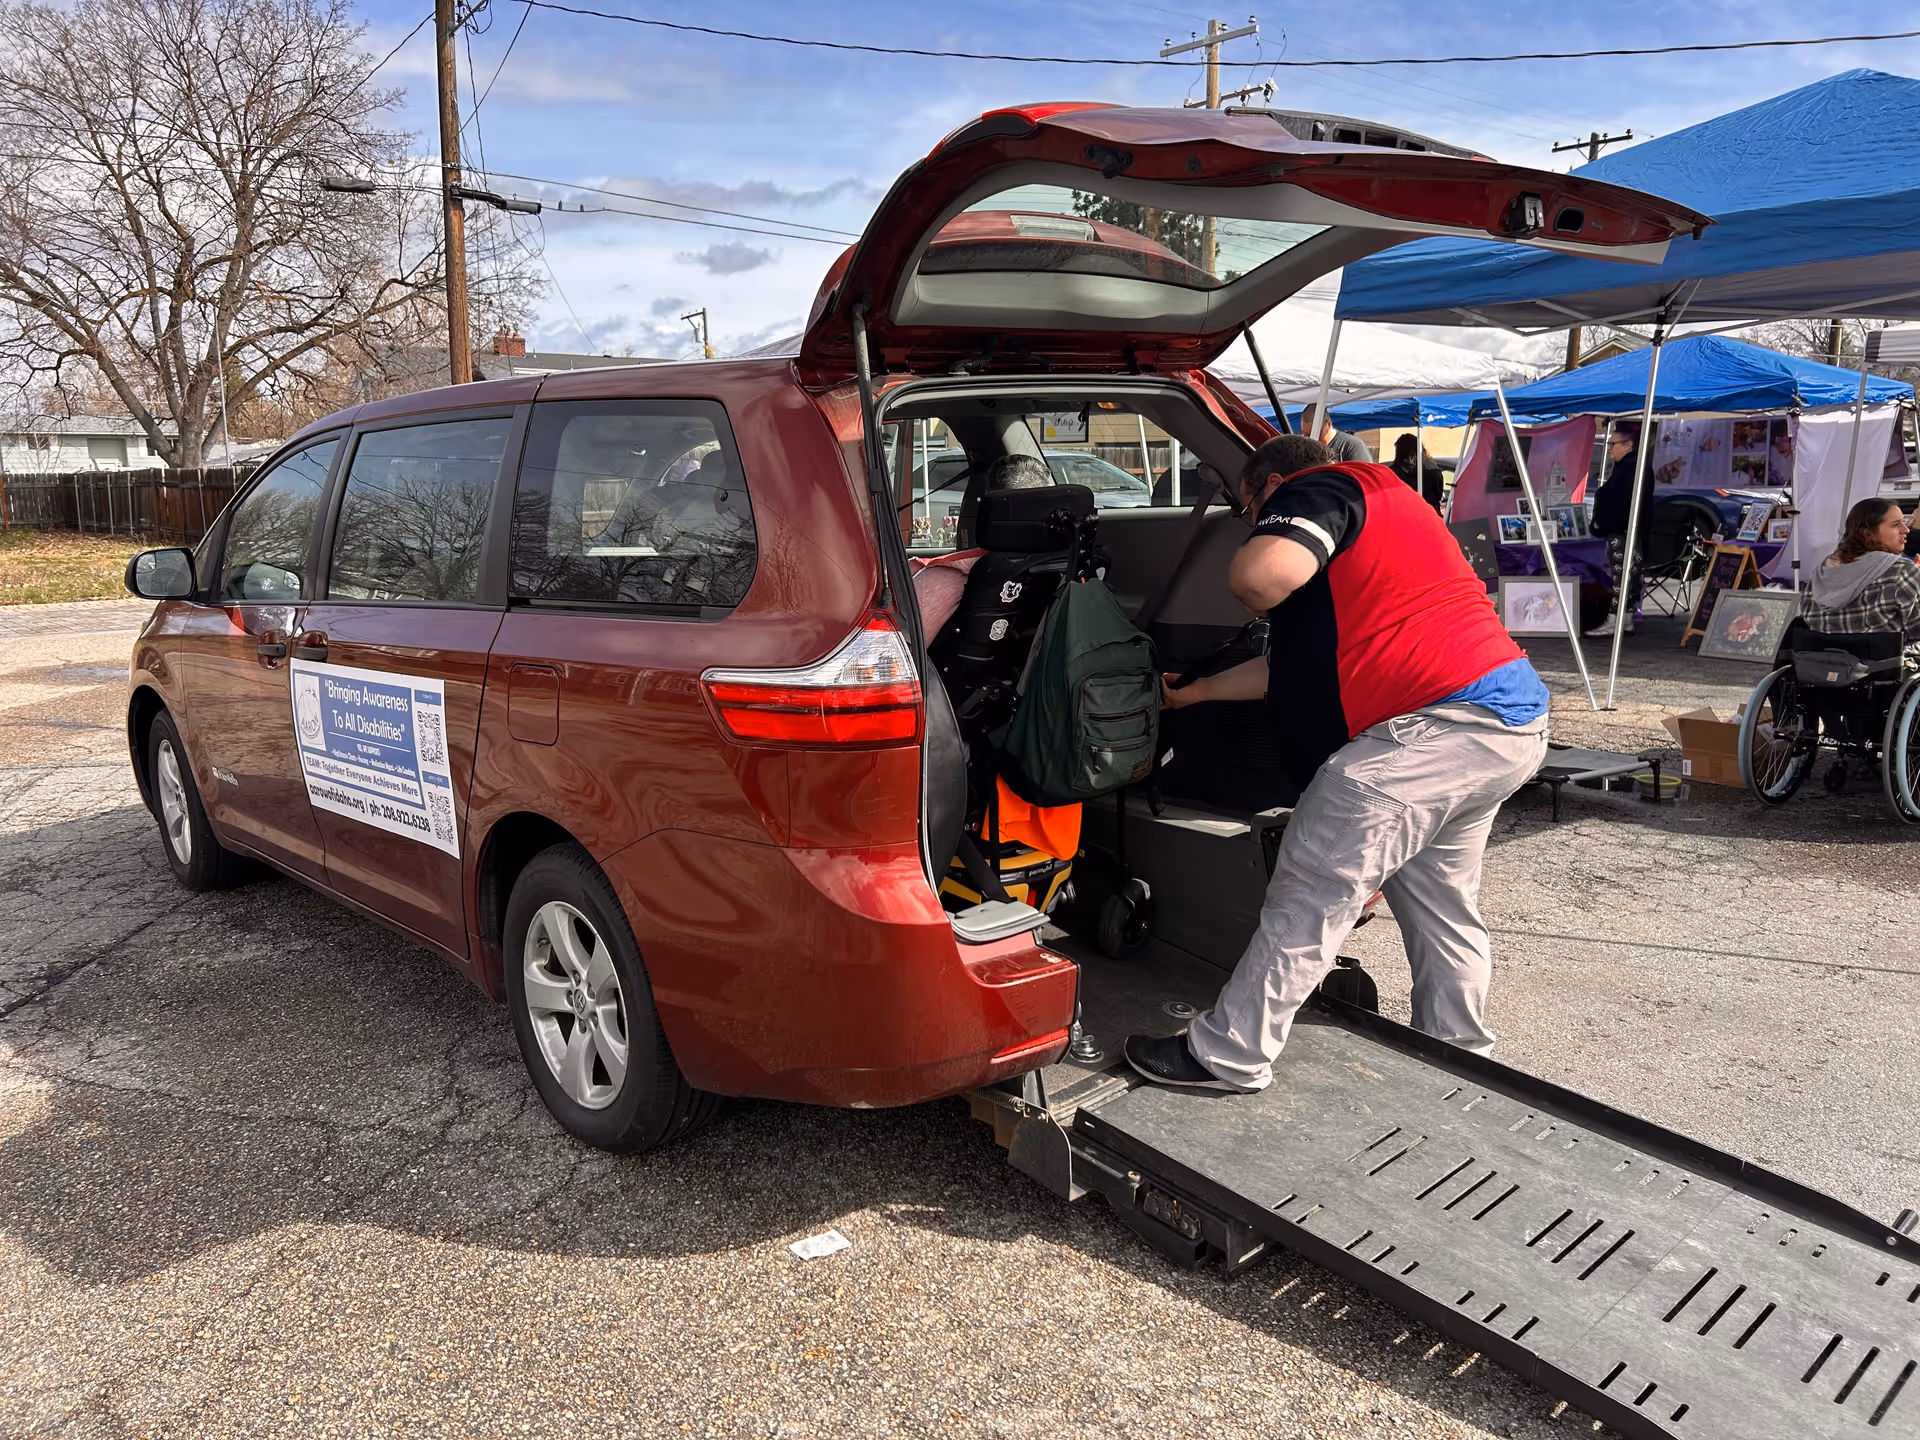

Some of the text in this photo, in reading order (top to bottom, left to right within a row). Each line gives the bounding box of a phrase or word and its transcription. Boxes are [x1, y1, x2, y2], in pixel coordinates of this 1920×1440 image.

[363, 686, 408, 712] Awareness
[332, 710, 343, 728] To
[345, 712, 356, 731] All
[305, 756, 321, 769] TEAM:
[321, 761, 346, 775] Together
[346, 768, 373, 783] Everyone
[373, 776, 400, 792] Achieves
[401, 782, 419, 796] More
[369, 800, 382, 817] ph:
[382, 804, 431, 832] 208.922.6238
